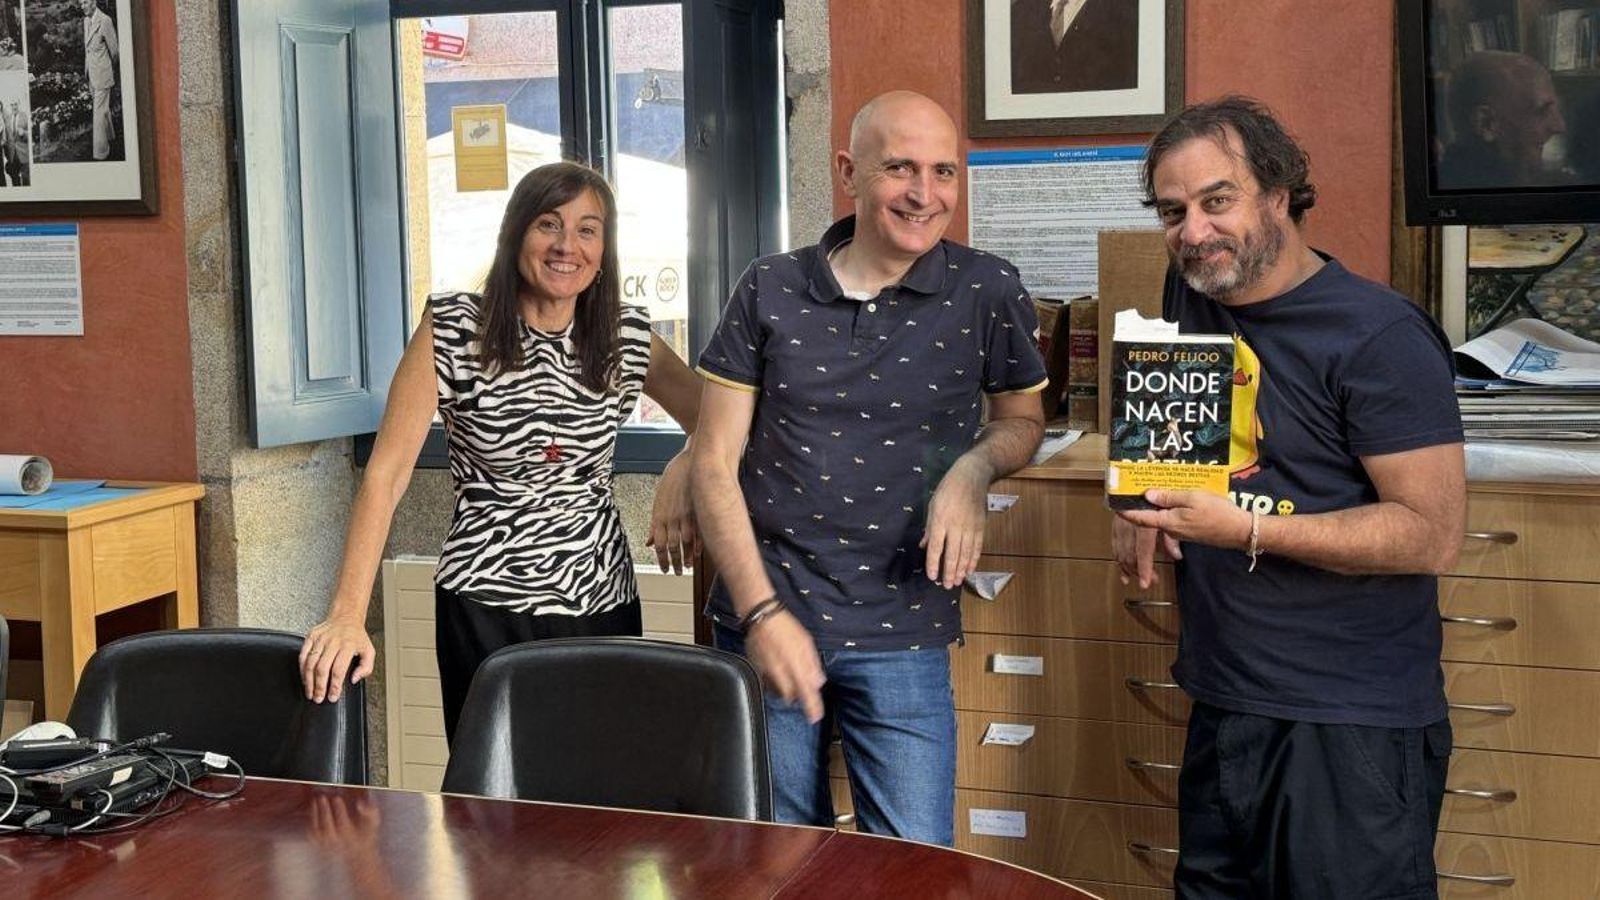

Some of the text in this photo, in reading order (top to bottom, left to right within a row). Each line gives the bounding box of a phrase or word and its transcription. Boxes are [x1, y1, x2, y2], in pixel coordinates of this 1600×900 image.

[1128, 350, 1220, 362] PEDRO FEIJOO
[1126, 370, 1220, 394] DONDE
[1125, 400, 1218, 423] NACEN
[1149, 430, 1194, 451] LAS
